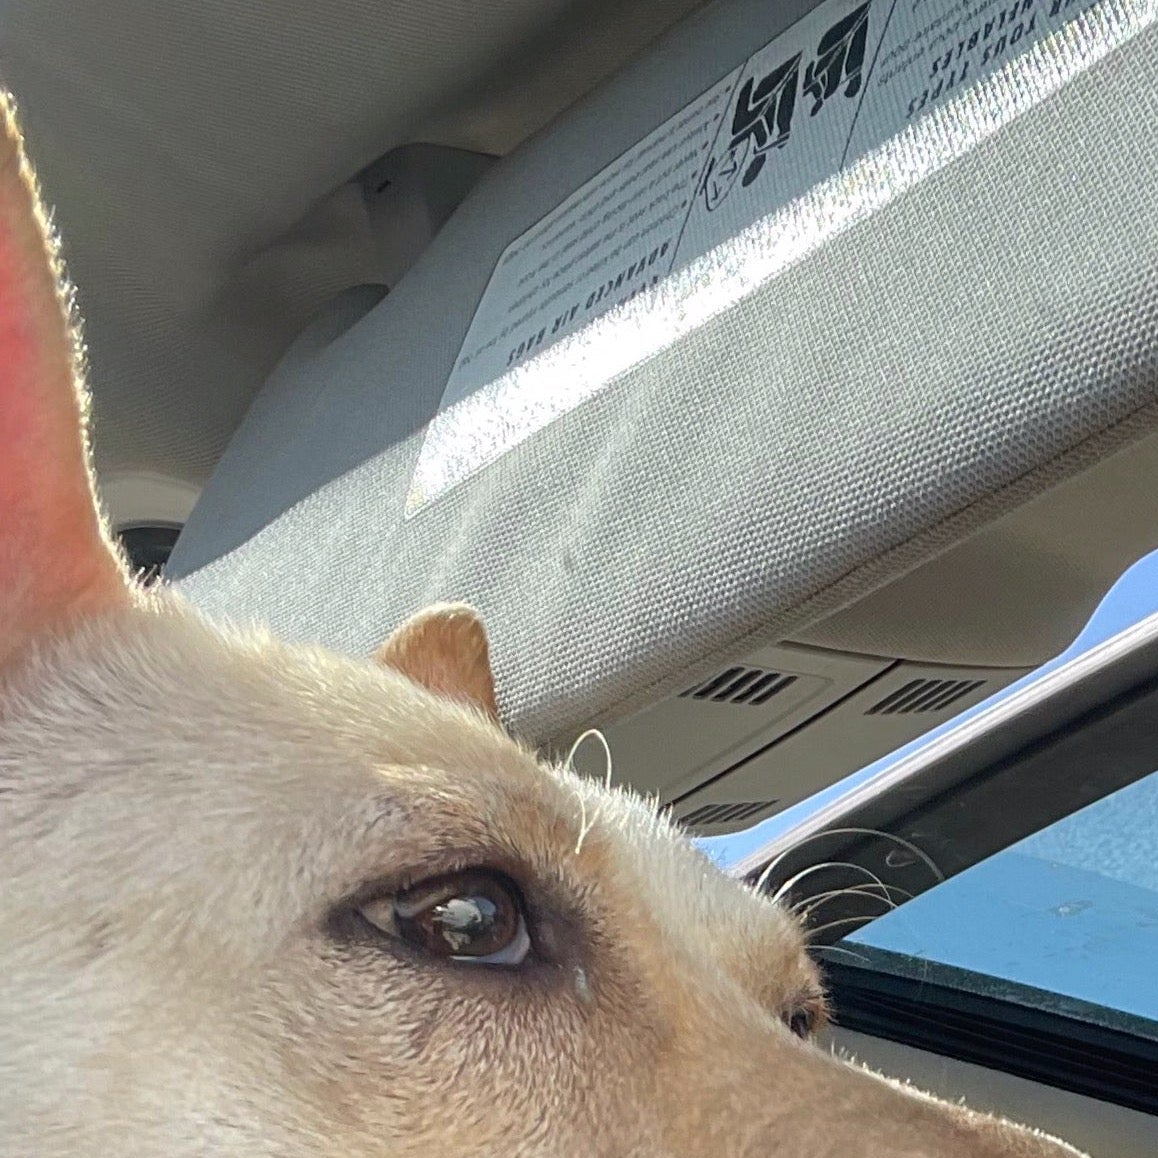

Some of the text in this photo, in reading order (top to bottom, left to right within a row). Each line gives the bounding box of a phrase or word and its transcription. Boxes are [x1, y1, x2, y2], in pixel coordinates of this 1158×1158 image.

[981, 12, 1036, 66] TOUS
[906, 61, 969, 119] TYPES
[585, 238, 672, 310] ADVANCED
[552, 303, 580, 334] AIR
[507, 326, 547, 366] BAGS
